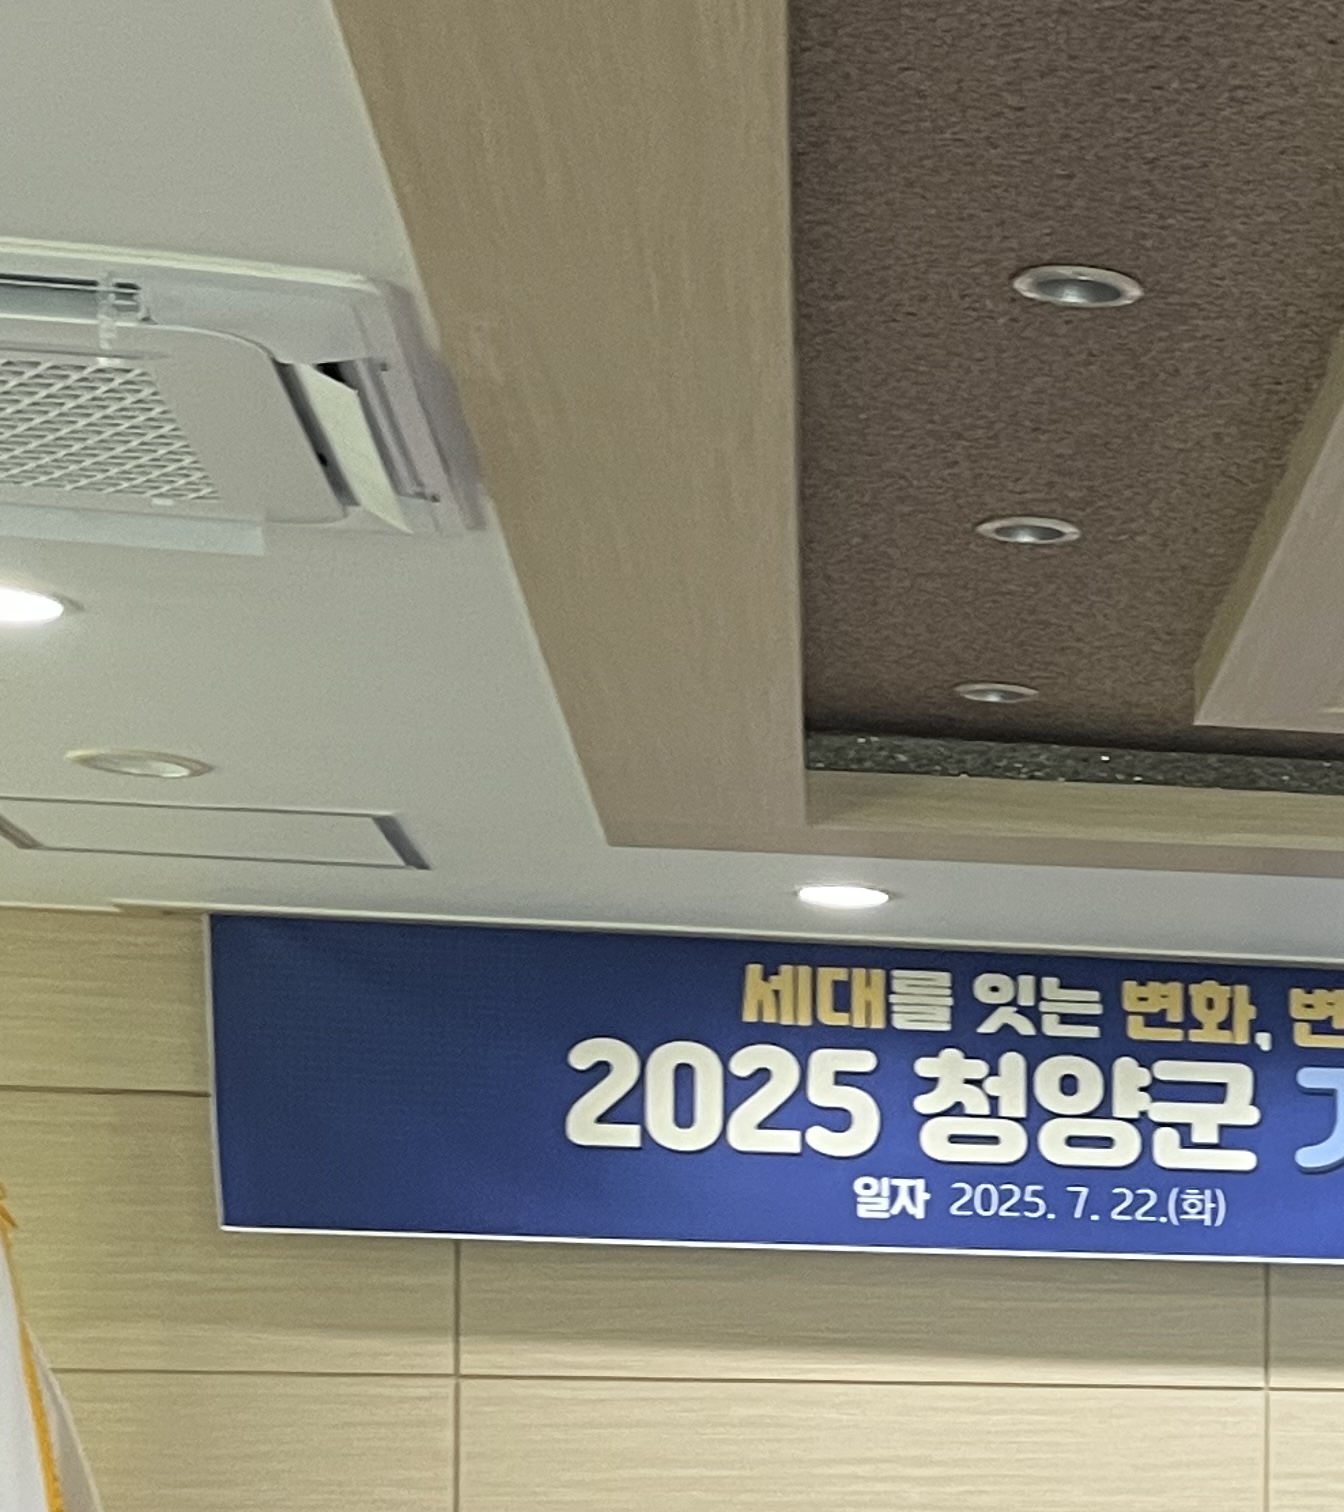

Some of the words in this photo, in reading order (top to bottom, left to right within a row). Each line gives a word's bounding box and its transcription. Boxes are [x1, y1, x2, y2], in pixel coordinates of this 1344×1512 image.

[743, 963, 953, 1031] 세대를
[972, 972, 1102, 1038] 잇는
[1121, 979, 1272, 1051] 변화,
[563, 1038, 881, 1159] 2025
[911, 1047, 1262, 1173] 청양군
[852, 1176, 931, 1220] 일자
